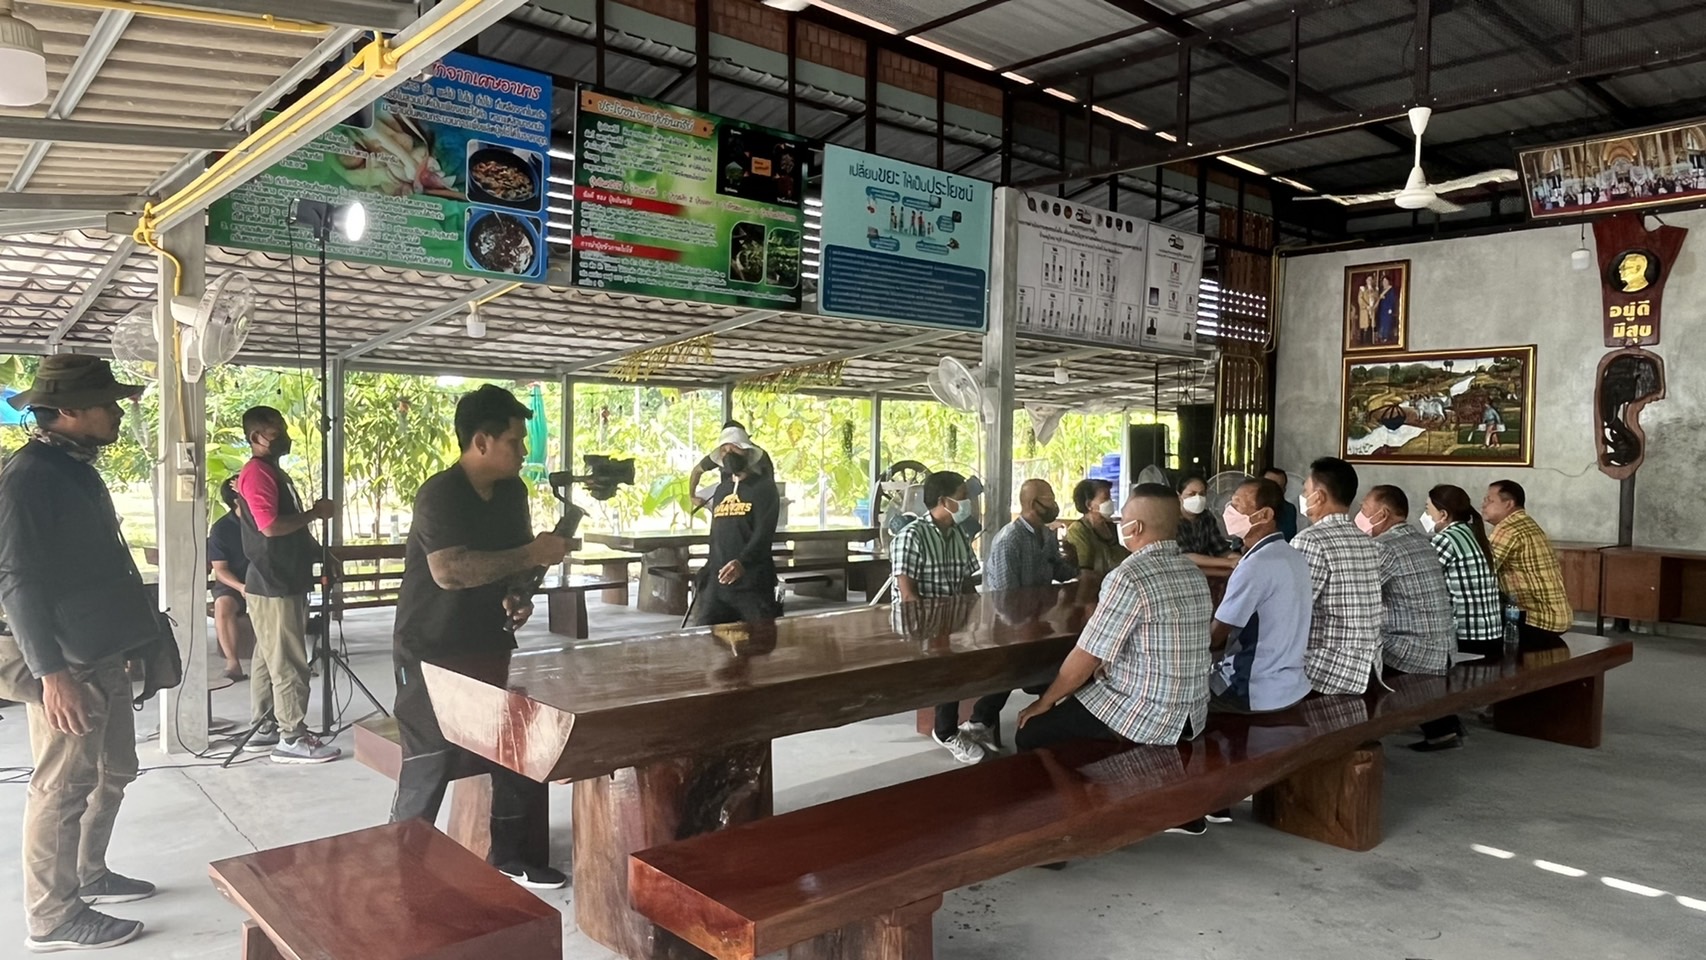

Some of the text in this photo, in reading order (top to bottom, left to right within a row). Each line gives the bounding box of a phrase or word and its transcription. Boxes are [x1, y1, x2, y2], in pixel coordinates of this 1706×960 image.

[849, 160, 900, 186] เปลี่ยนขยะ
[902, 170, 974, 202] ให้เป็นประโยชน์
[1609, 299, 1650, 322] อยู่ดี
[1612, 322, 1652, 344] มีสุข
